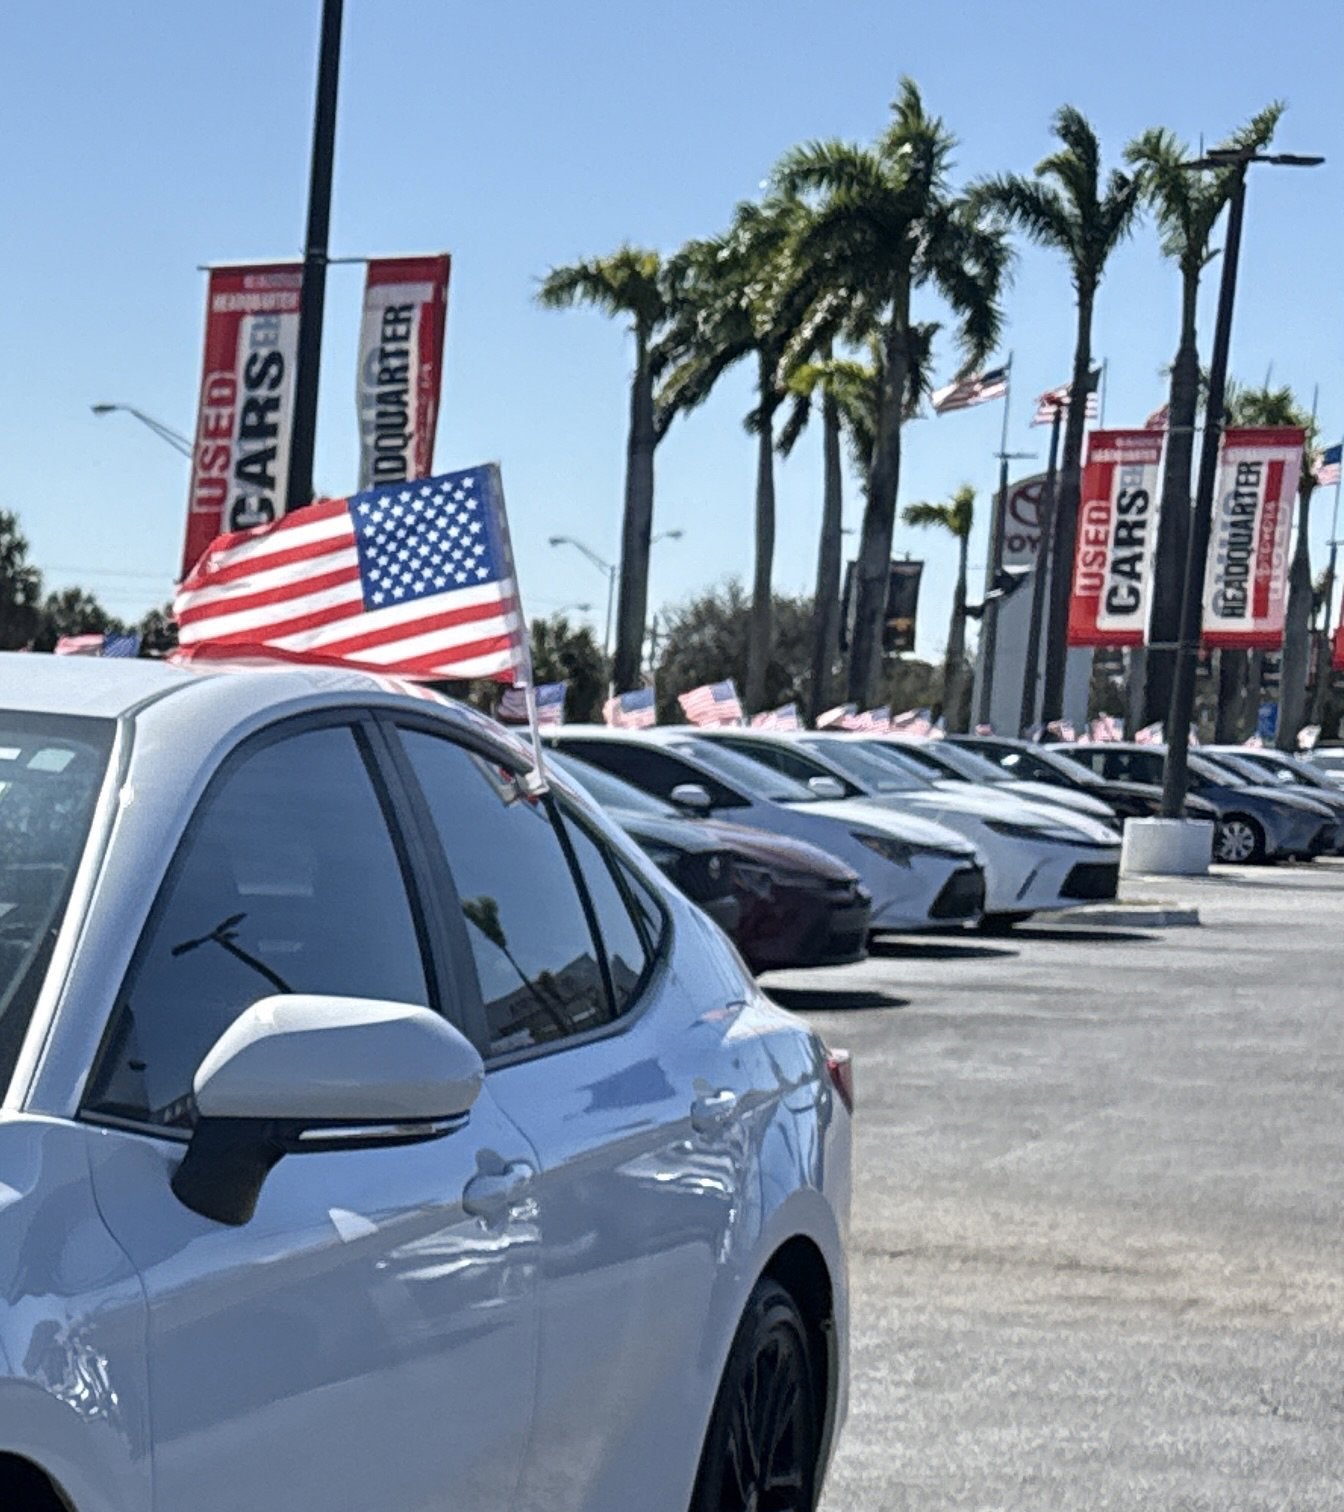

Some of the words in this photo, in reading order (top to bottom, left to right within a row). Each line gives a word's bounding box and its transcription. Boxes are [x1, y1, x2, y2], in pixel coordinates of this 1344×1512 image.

[191, 372, 237, 512] USED
[229, 351, 285, 532] CARS
[1079, 502, 1112, 594] USED
[1105, 487, 1150, 616] CARS
[1221, 460, 1262, 619] HEADQUARTER
